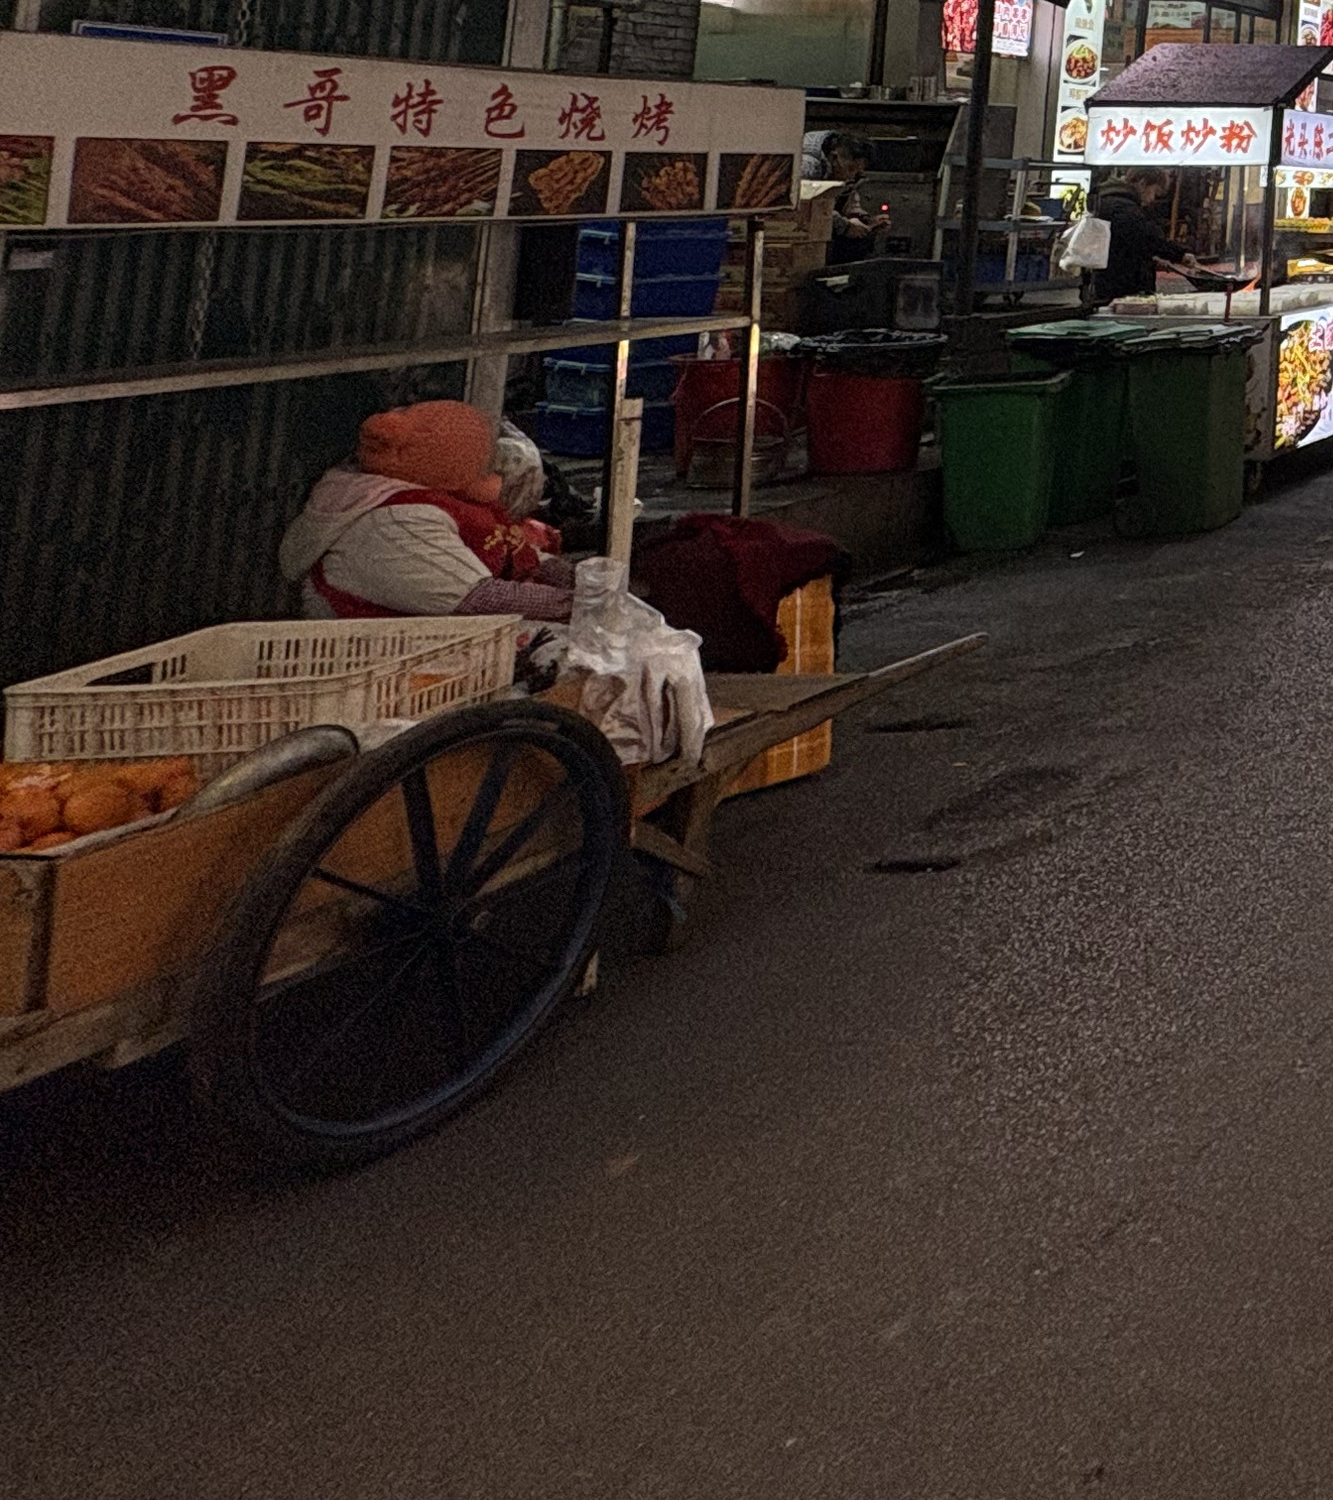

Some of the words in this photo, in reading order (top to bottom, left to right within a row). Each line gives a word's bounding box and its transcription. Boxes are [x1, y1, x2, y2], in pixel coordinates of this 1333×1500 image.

[171, 65, 675, 147] 黑哥特色烧烤
[1100, 117, 1258, 156] 炒饭炒粉
